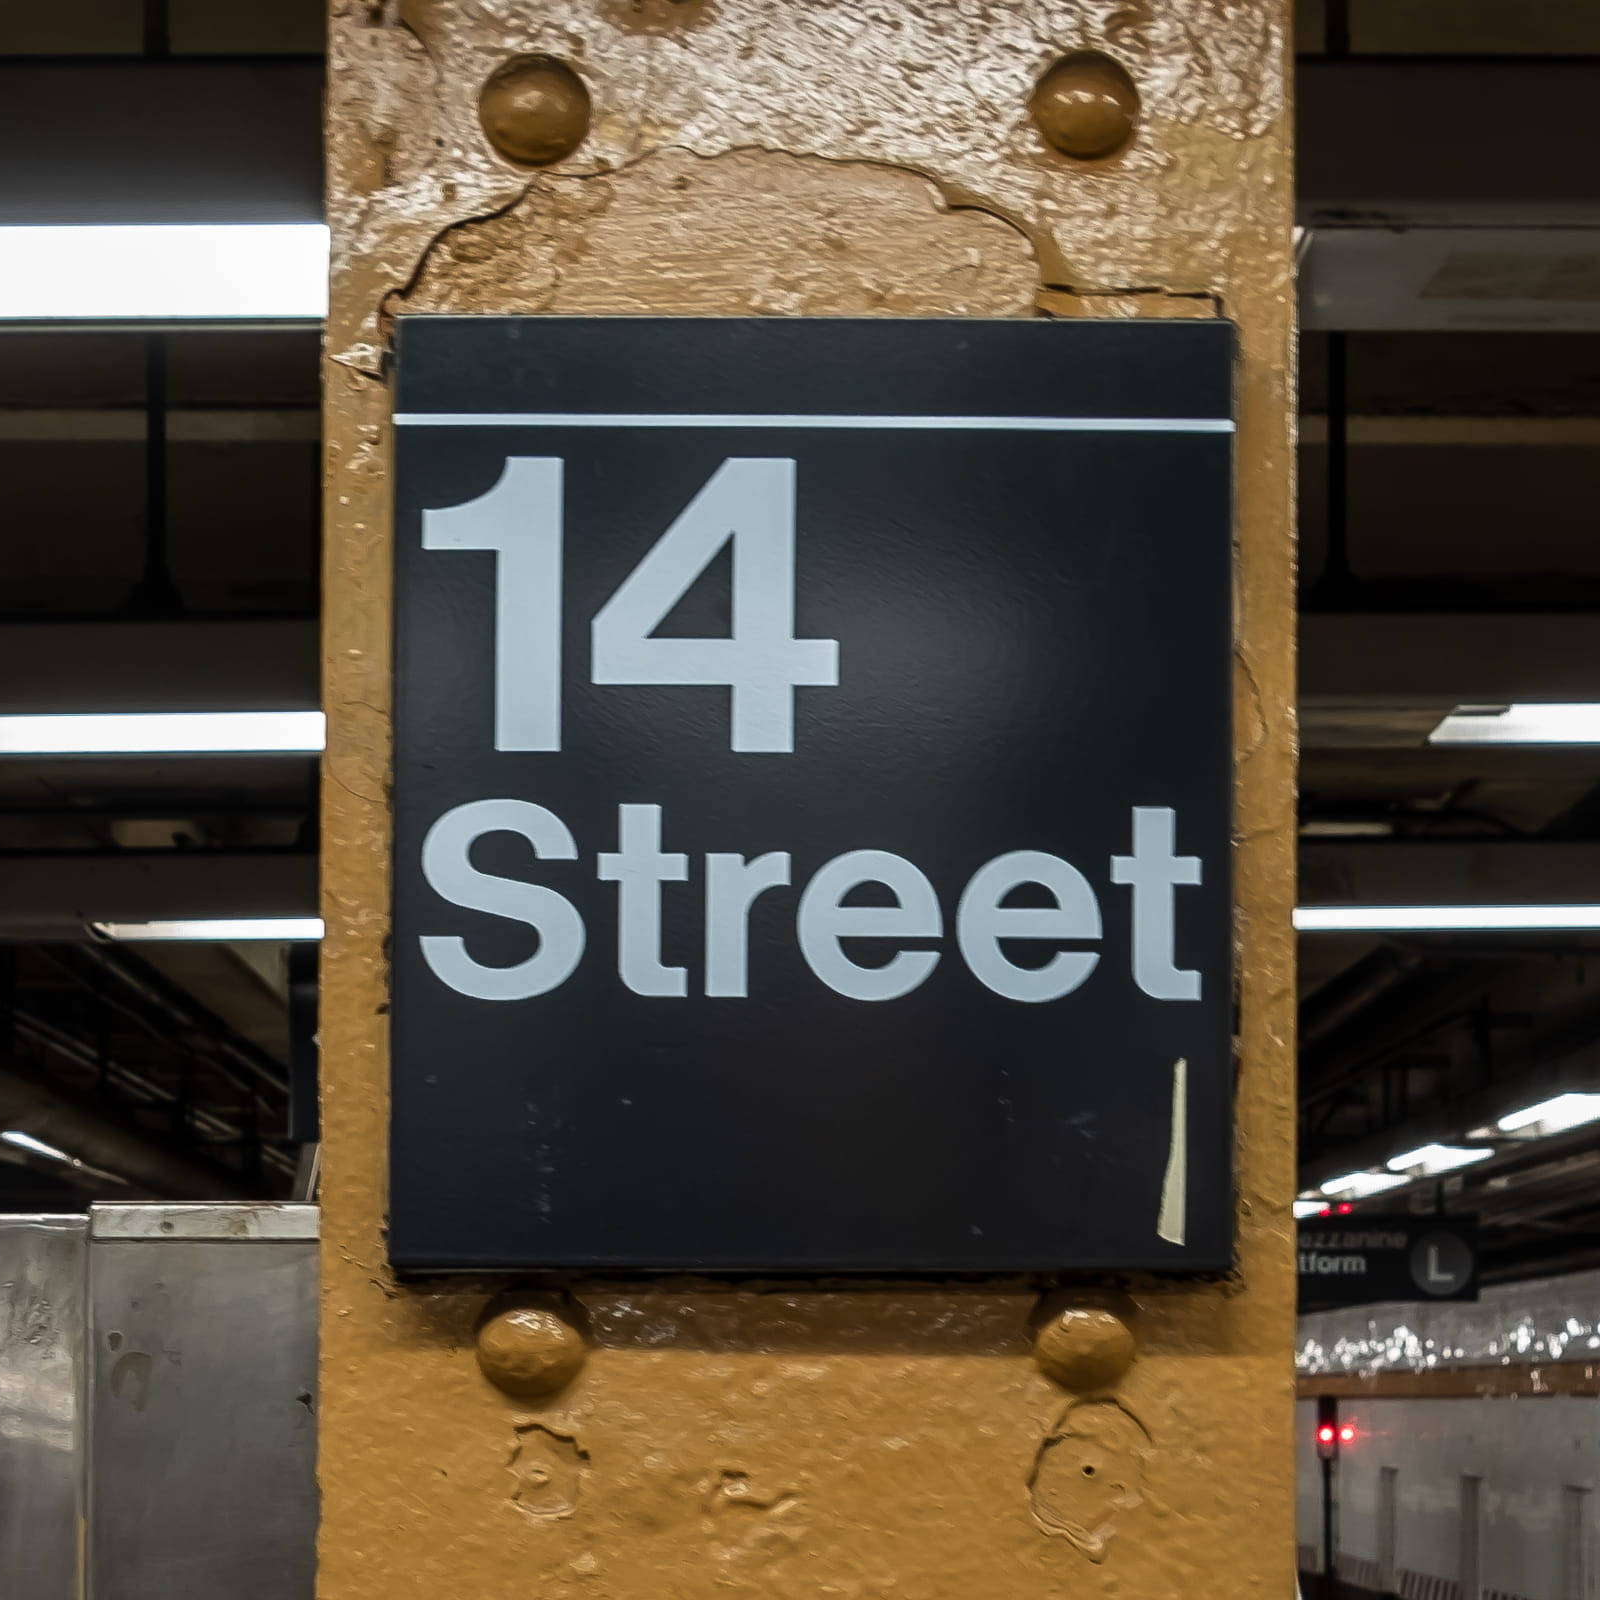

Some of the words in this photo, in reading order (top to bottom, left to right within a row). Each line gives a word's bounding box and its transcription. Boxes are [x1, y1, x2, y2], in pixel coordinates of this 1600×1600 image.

[422, 456, 839, 753] 14
[419, 799, 1201, 1002] Street
[1427, 1245, 1456, 1281] L
